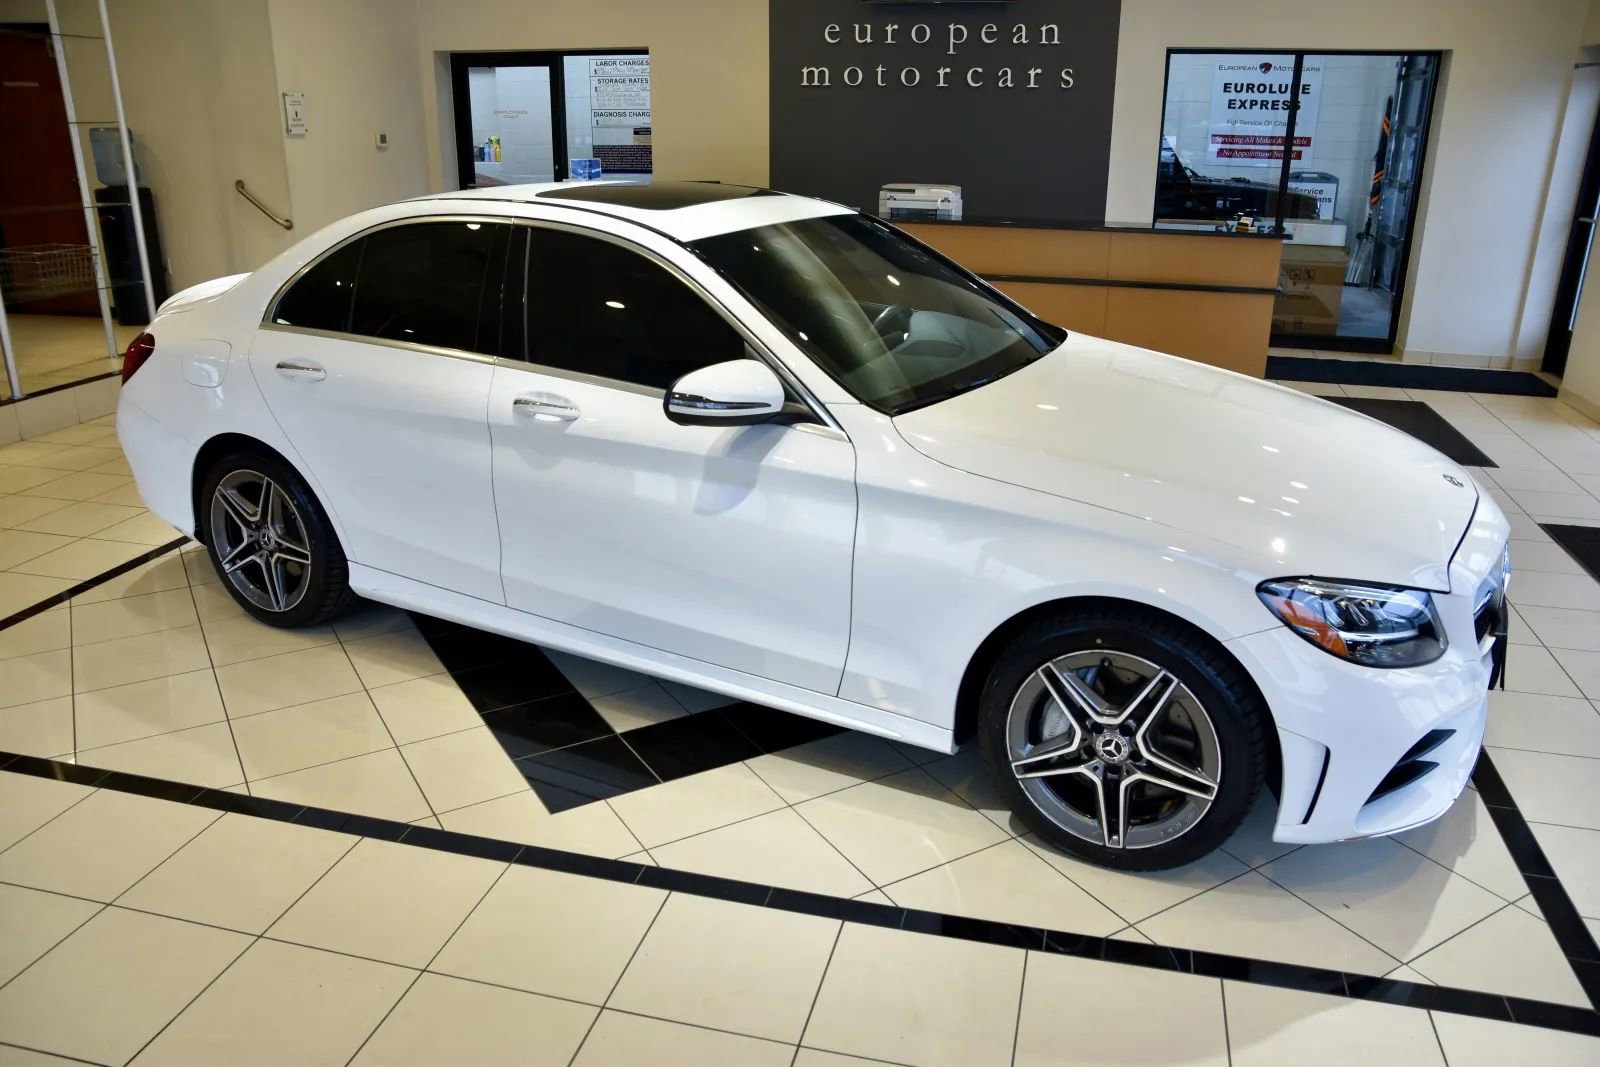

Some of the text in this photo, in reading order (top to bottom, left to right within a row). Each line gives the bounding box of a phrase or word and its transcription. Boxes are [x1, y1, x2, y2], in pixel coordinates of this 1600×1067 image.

[824, 22, 1061, 54] european
[800, 64, 1074, 89] motorcars
[1223, 82, 1312, 95] EUROLUE
